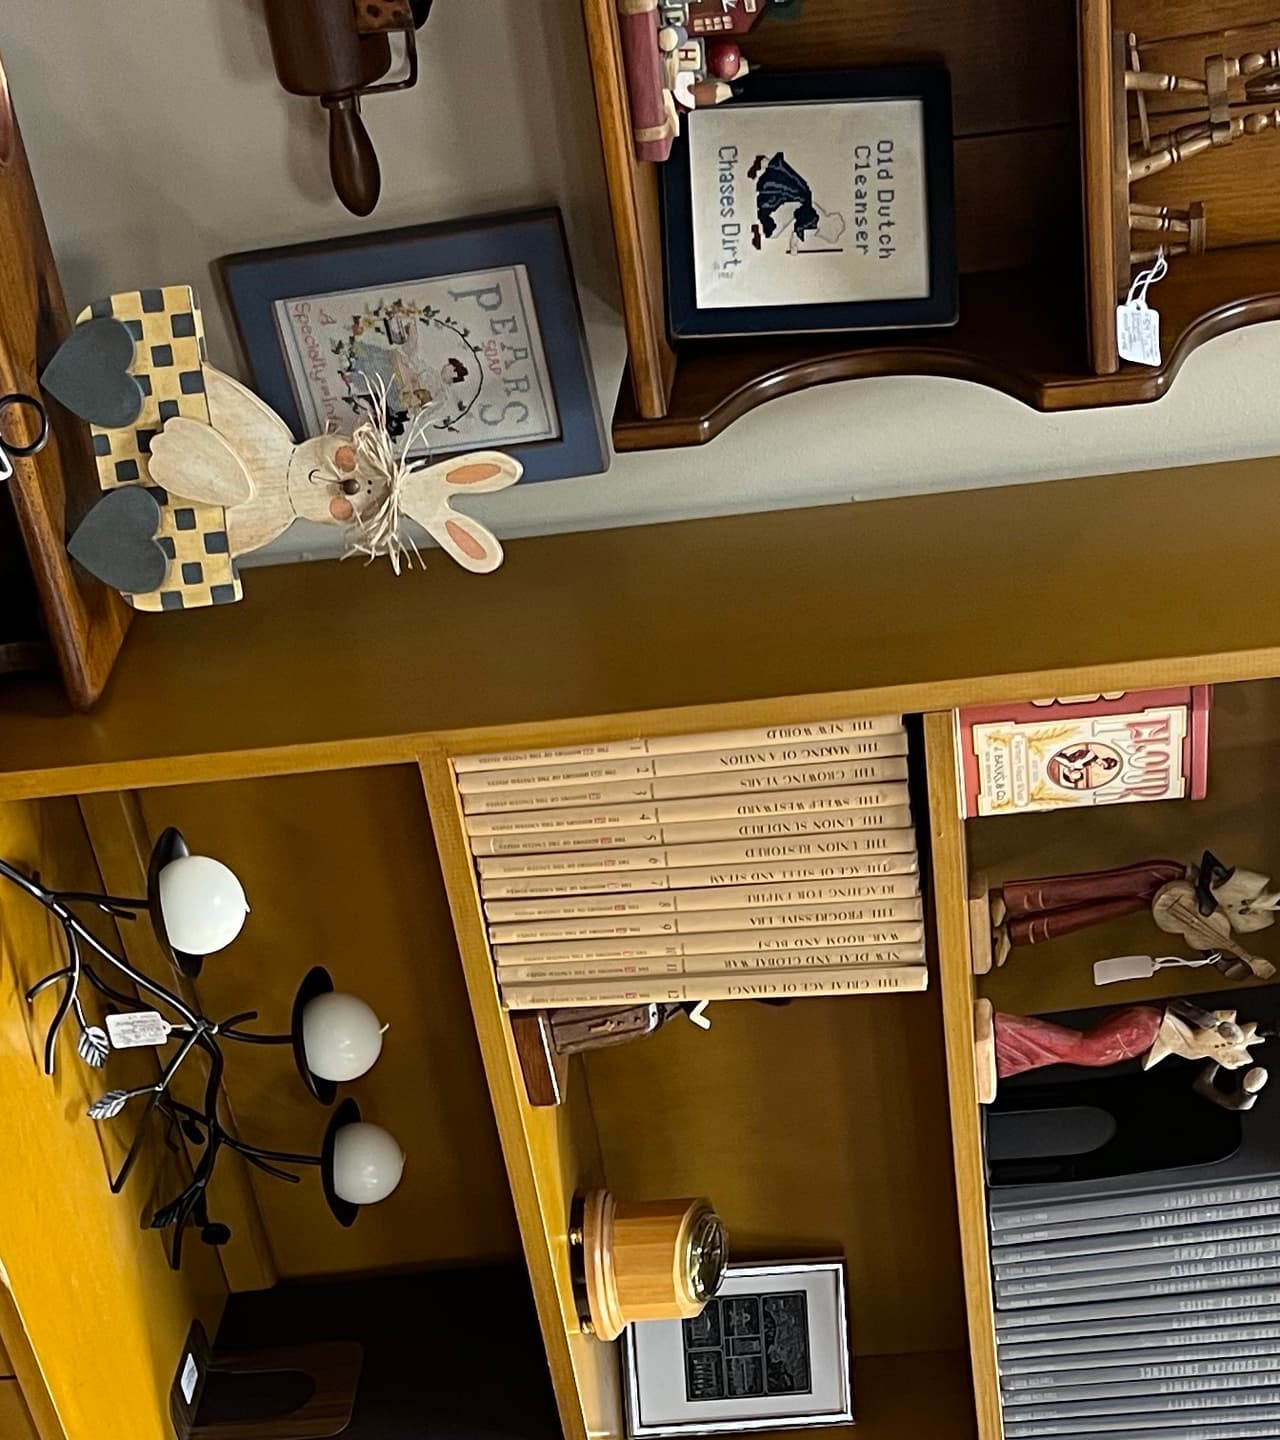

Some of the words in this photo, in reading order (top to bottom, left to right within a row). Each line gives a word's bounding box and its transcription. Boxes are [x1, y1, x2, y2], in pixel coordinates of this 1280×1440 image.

[876, 140, 894, 180] Old
[718, 145, 739, 218] Chases
[854, 145, 871, 256] Cleanser
[878, 189, 896, 259] Dutch
[320, 309, 337, 326] A
[293, 302, 328, 381] Specialty
[448, 283, 529, 426] PEARS
[483, 339, 502, 376] SOAP
[814, 723, 843, 735] NEW
[848, 718, 873, 730] THE
[766, 726, 811, 740] WORLD
[801, 744, 850, 759] MAKING
[854, 741, 879, 753] THE
[719, 753, 767, 767] NATION
[1092, 714, 1171, 804] FLOUR
[782, 770, 845, 785] GROWING
[850, 766, 876, 778] THE
[739, 775, 778, 788] YEARS
[856, 794, 880, 805] THE
[736, 801, 805, 815] WESTWARD
[813, 817, 854, 830] UNION
[859, 814, 883, 825] THE
[738, 821, 807, 835] SUNDERED
[817, 840, 858, 853] UNION
[864, 838, 887, 849] THE
[745, 843, 811, 858] RESTORED
[839, 865, 862, 876] AGE
[867, 863, 888, 874] THE
[750, 871, 775, 882] AND
[828, 884, 895, 897] REACHING
[778, 910, 864, 924] PROGRESSIVE
[872, 908, 893, 918] THE
[749, 916, 773, 926] ERA
[794, 937, 821, 946] AND
[826, 934, 865, 944] BOOM
[755, 955, 802, 967] GLOBAL
[805, 953, 831, 964] AND
[874, 951, 901, 961] NEW
[723, 958, 749, 968] WAR
[801, 982, 824, 992] AGE
[878, 978, 898, 988] THE
